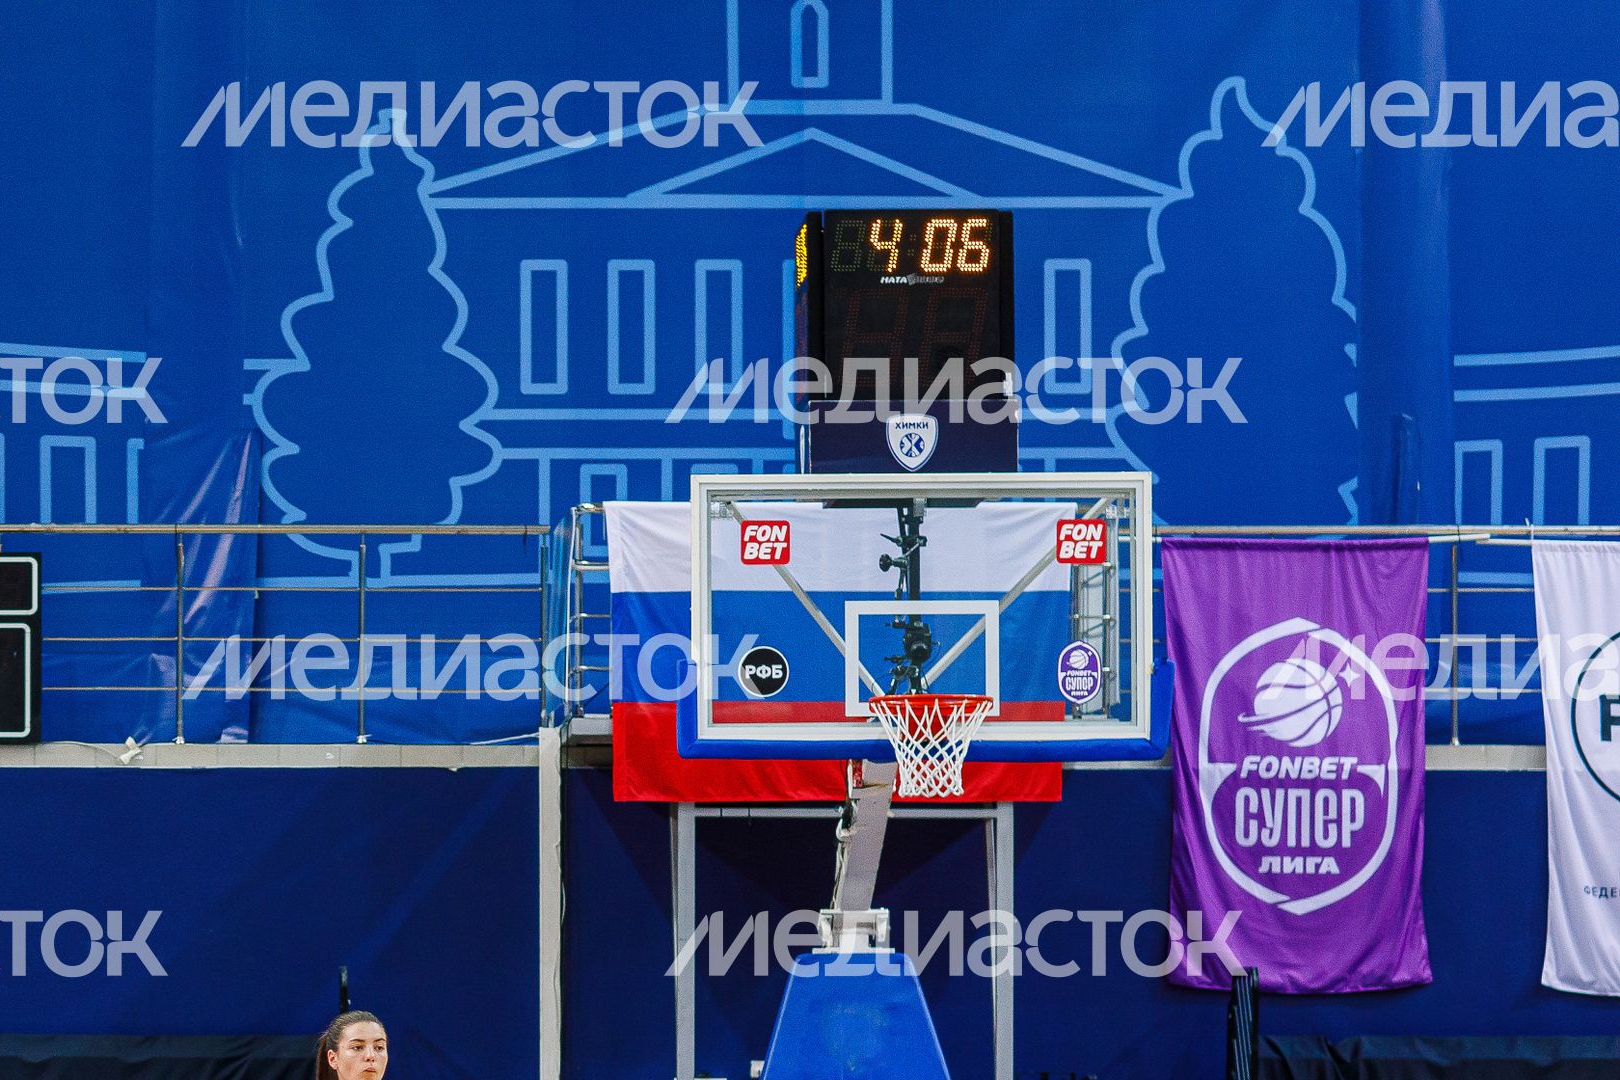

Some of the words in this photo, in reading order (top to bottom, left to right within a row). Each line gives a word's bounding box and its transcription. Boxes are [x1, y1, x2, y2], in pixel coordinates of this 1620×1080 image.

[744, 525, 787, 541] FON
[1059, 524, 1102, 540] FON
[744, 542, 787, 560] BET
[1059, 541, 1102, 559] BET
[745, 664, 783, 679] РФБ
[1240, 755, 1358, 780] FONBET
[1259, 856, 1340, 874] ЛИГА
[1584, 886, 1620, 898] ФЕДЕ
